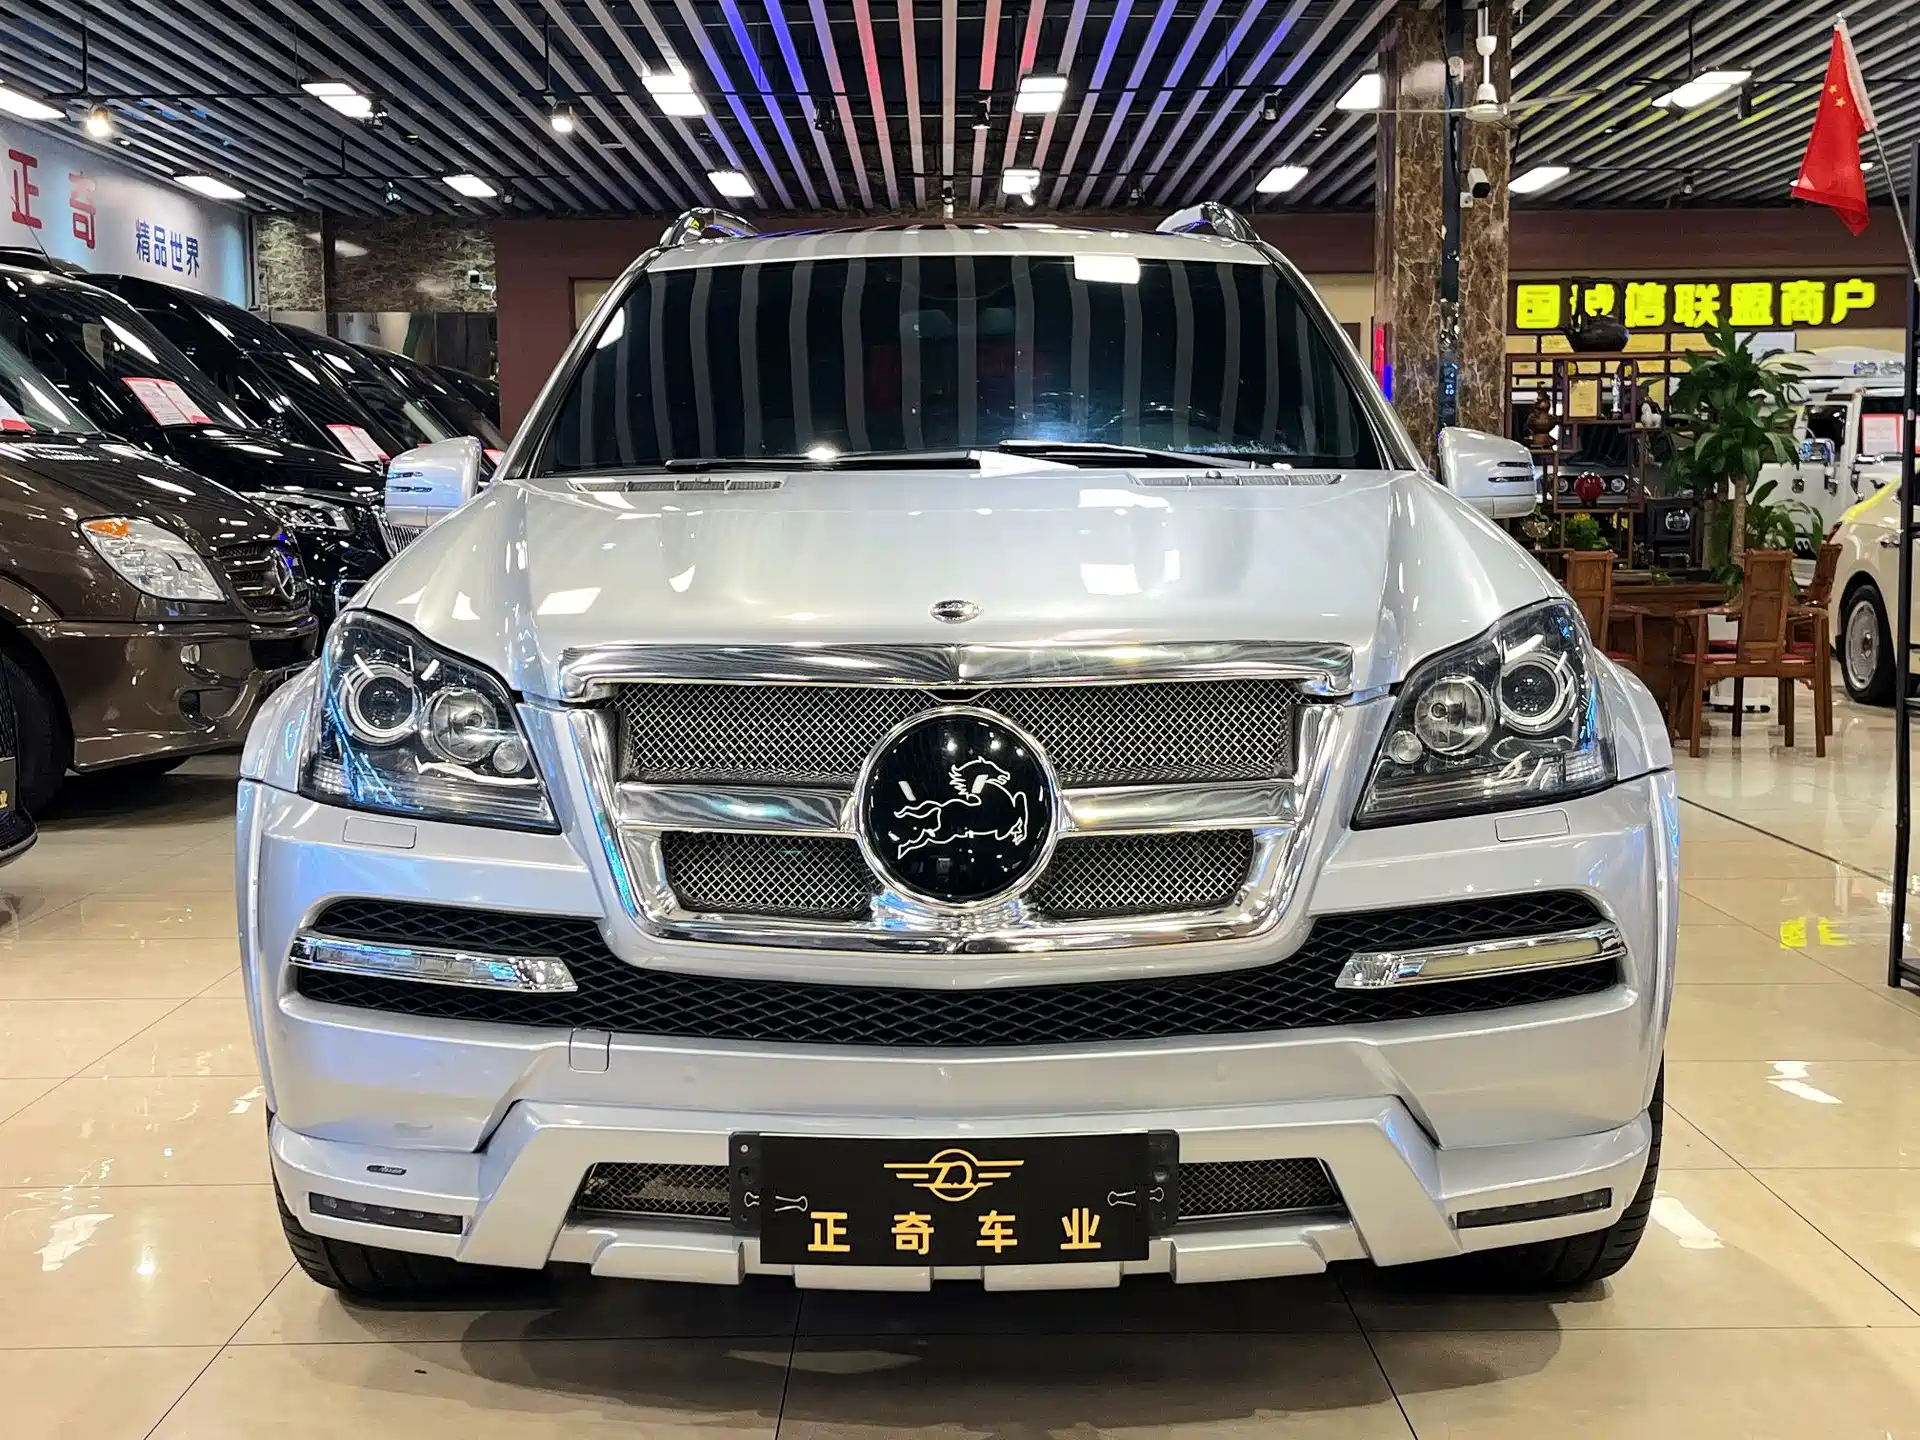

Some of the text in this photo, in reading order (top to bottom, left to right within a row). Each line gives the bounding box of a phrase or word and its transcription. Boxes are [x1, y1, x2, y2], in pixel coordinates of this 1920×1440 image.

[135, 216, 200, 278] 精品世界
[807, 1207, 1102, 1256] 正奇车业
